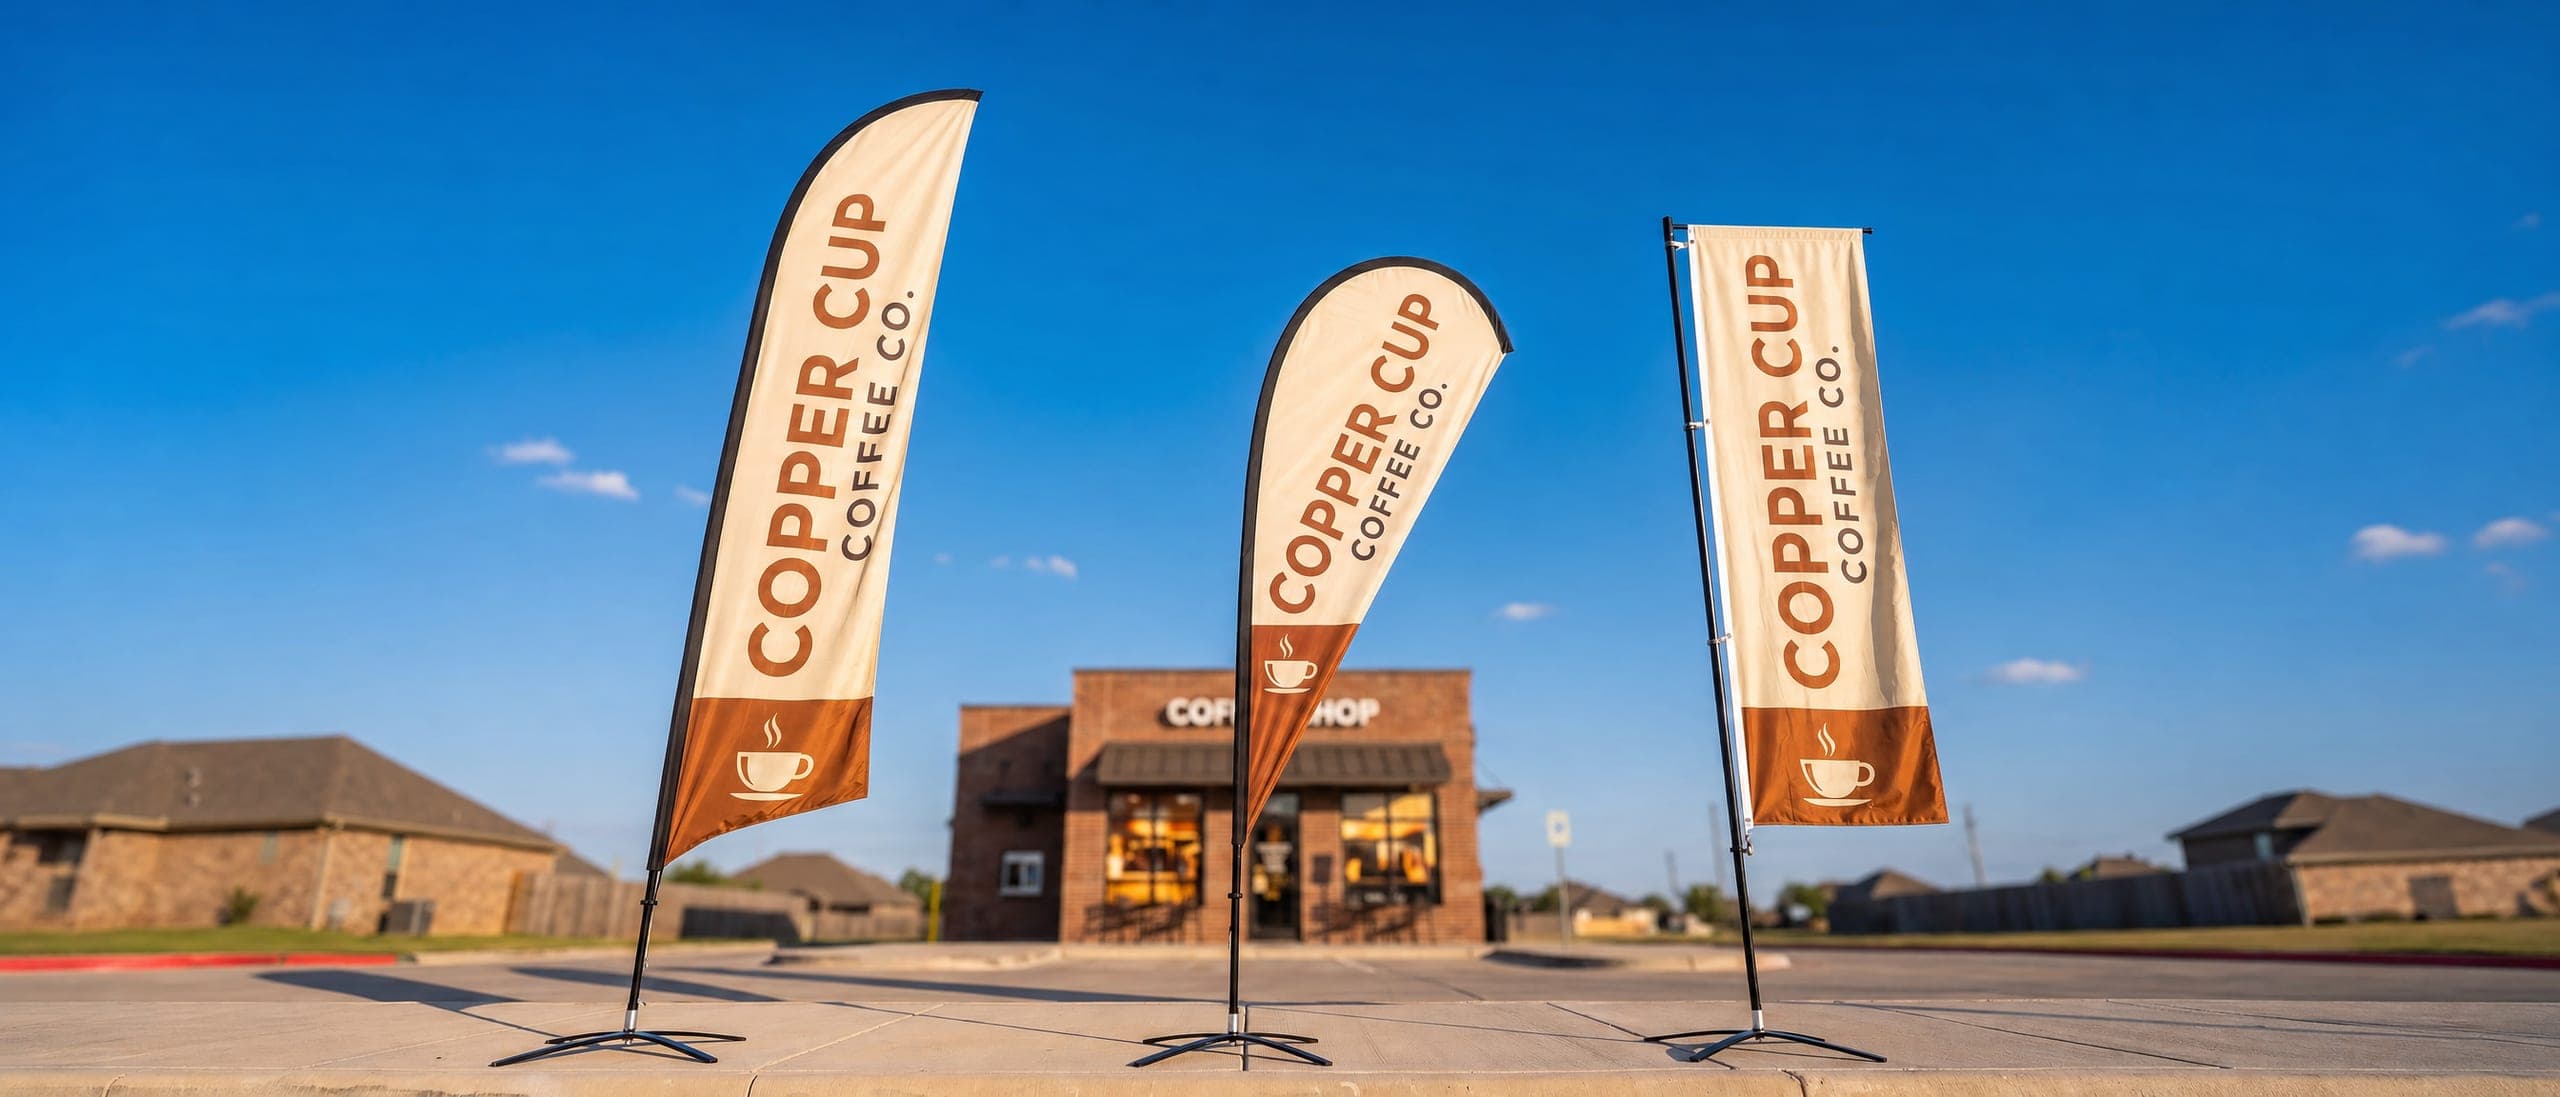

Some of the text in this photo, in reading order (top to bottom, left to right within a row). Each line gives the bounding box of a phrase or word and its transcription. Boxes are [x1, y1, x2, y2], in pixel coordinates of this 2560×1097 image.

[748, 193, 886, 678] COPPER CUP
[841, 291, 916, 562] COFFEE CO.
[1269, 293, 1440, 615] COPPER CUP
[1351, 383, 1449, 562] COFFEE CO.
[1745, 254, 1841, 689] COPPER CUP
[1815, 346, 1868, 584] COFFEE CO.
[1166, 697, 1380, 727] COF HOP
